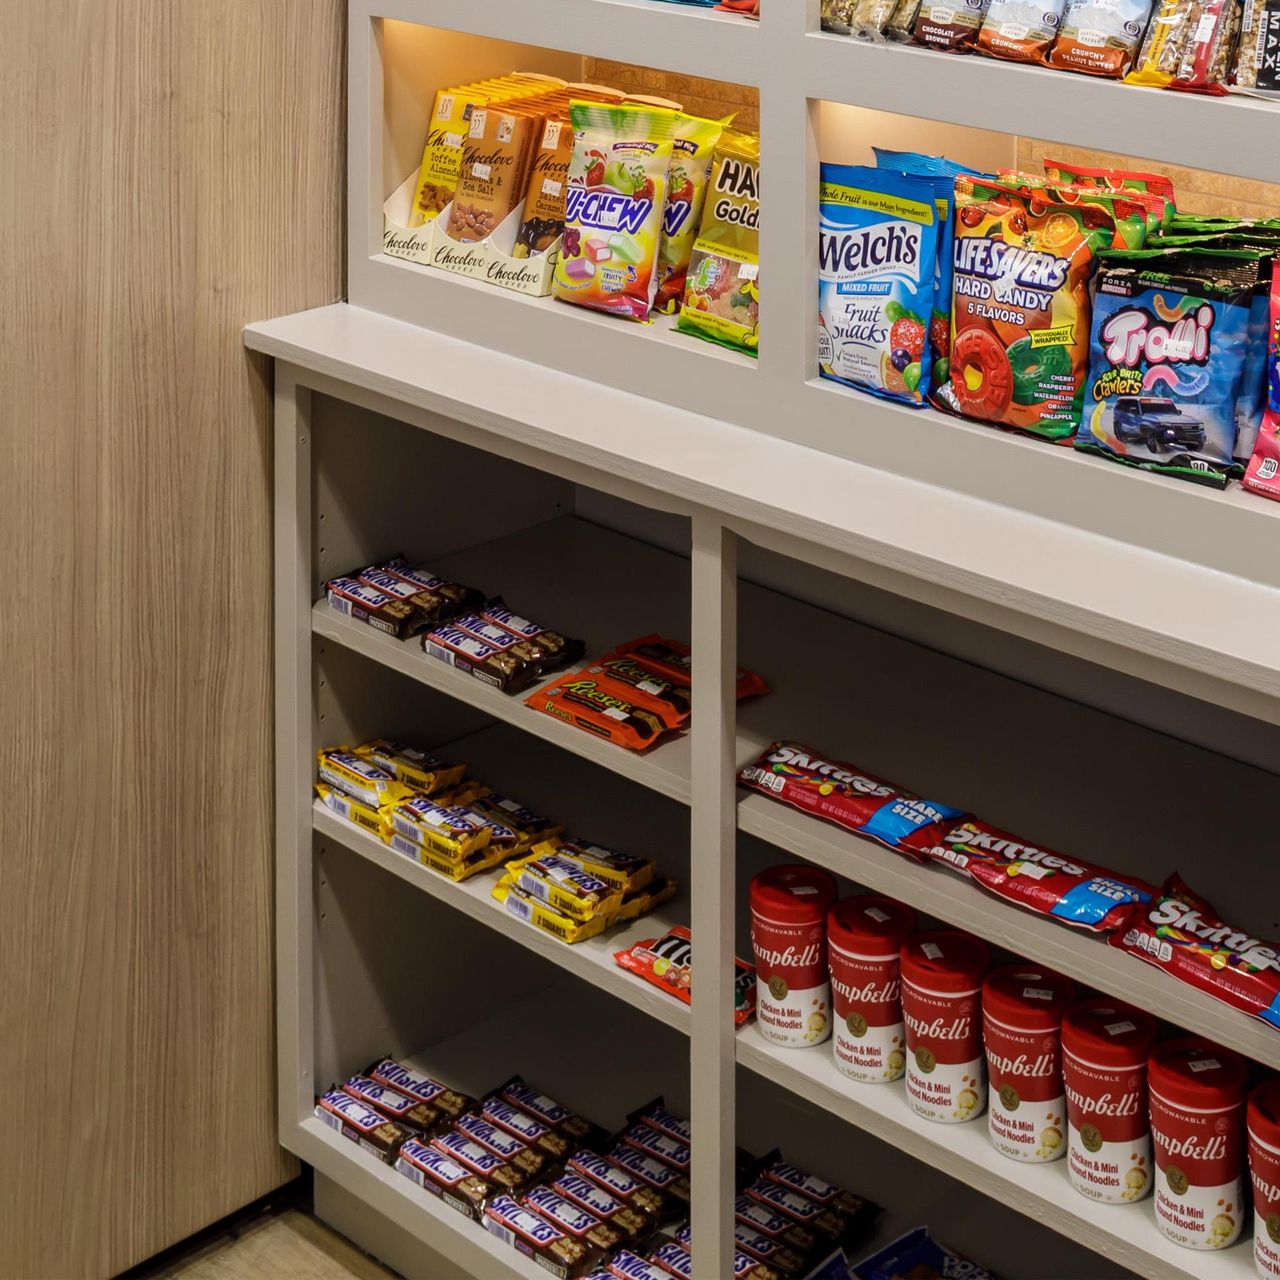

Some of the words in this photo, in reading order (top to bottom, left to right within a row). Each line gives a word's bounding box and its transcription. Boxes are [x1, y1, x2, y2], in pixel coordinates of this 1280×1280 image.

[922, 26, 954, 38] CHOCOLATE
[1264, 11, 1280, 69] MAX
[1071, 48, 1104, 60] CRUNCHY
[430, 152, 456, 165] Toffee
[462, 147, 513, 166] Chocolove
[430, 164, 460, 177] Almonds
[463, 182, 475, 192] Sea
[478, 185, 493, 194] Salt
[840, 192, 861, 204] Fruit
[880, 201, 894, 210] Main
[435, 245, 485, 269] Chocolove
[820, 226, 918, 272] Welch's
[955, 240, 988, 272] LIFE
[988, 244, 1070, 286] SAVERS
[488, 260, 539, 285] Chocolove
[842, 284, 865, 292] MIXED
[868, 283, 889, 292] FRUIT
[956, 278, 990, 299] HARD
[994, 288, 1051, 310] CANDY
[845, 303, 881, 322] Fruit
[968, 303, 973, 314] 5
[976, 304, 1024, 324] FLAVORS
[1105, 306, 1212, 365] Trolli
[1039, 382, 1074, 391] RASPBERRY
[1093, 379, 1143, 401] Crawlers
[1264, 460, 1276, 472] 100
[892, 804, 926, 824] SIZE
[944, 822, 1086, 877] Skittles
[1089, 884, 1124, 900] SIZE
[537, 915, 542, 923] 2
[761, 1000, 779, 1015] Chicken
[787, 1009, 801, 1017] Mini
[778, 1019, 802, 1029] Noodles
